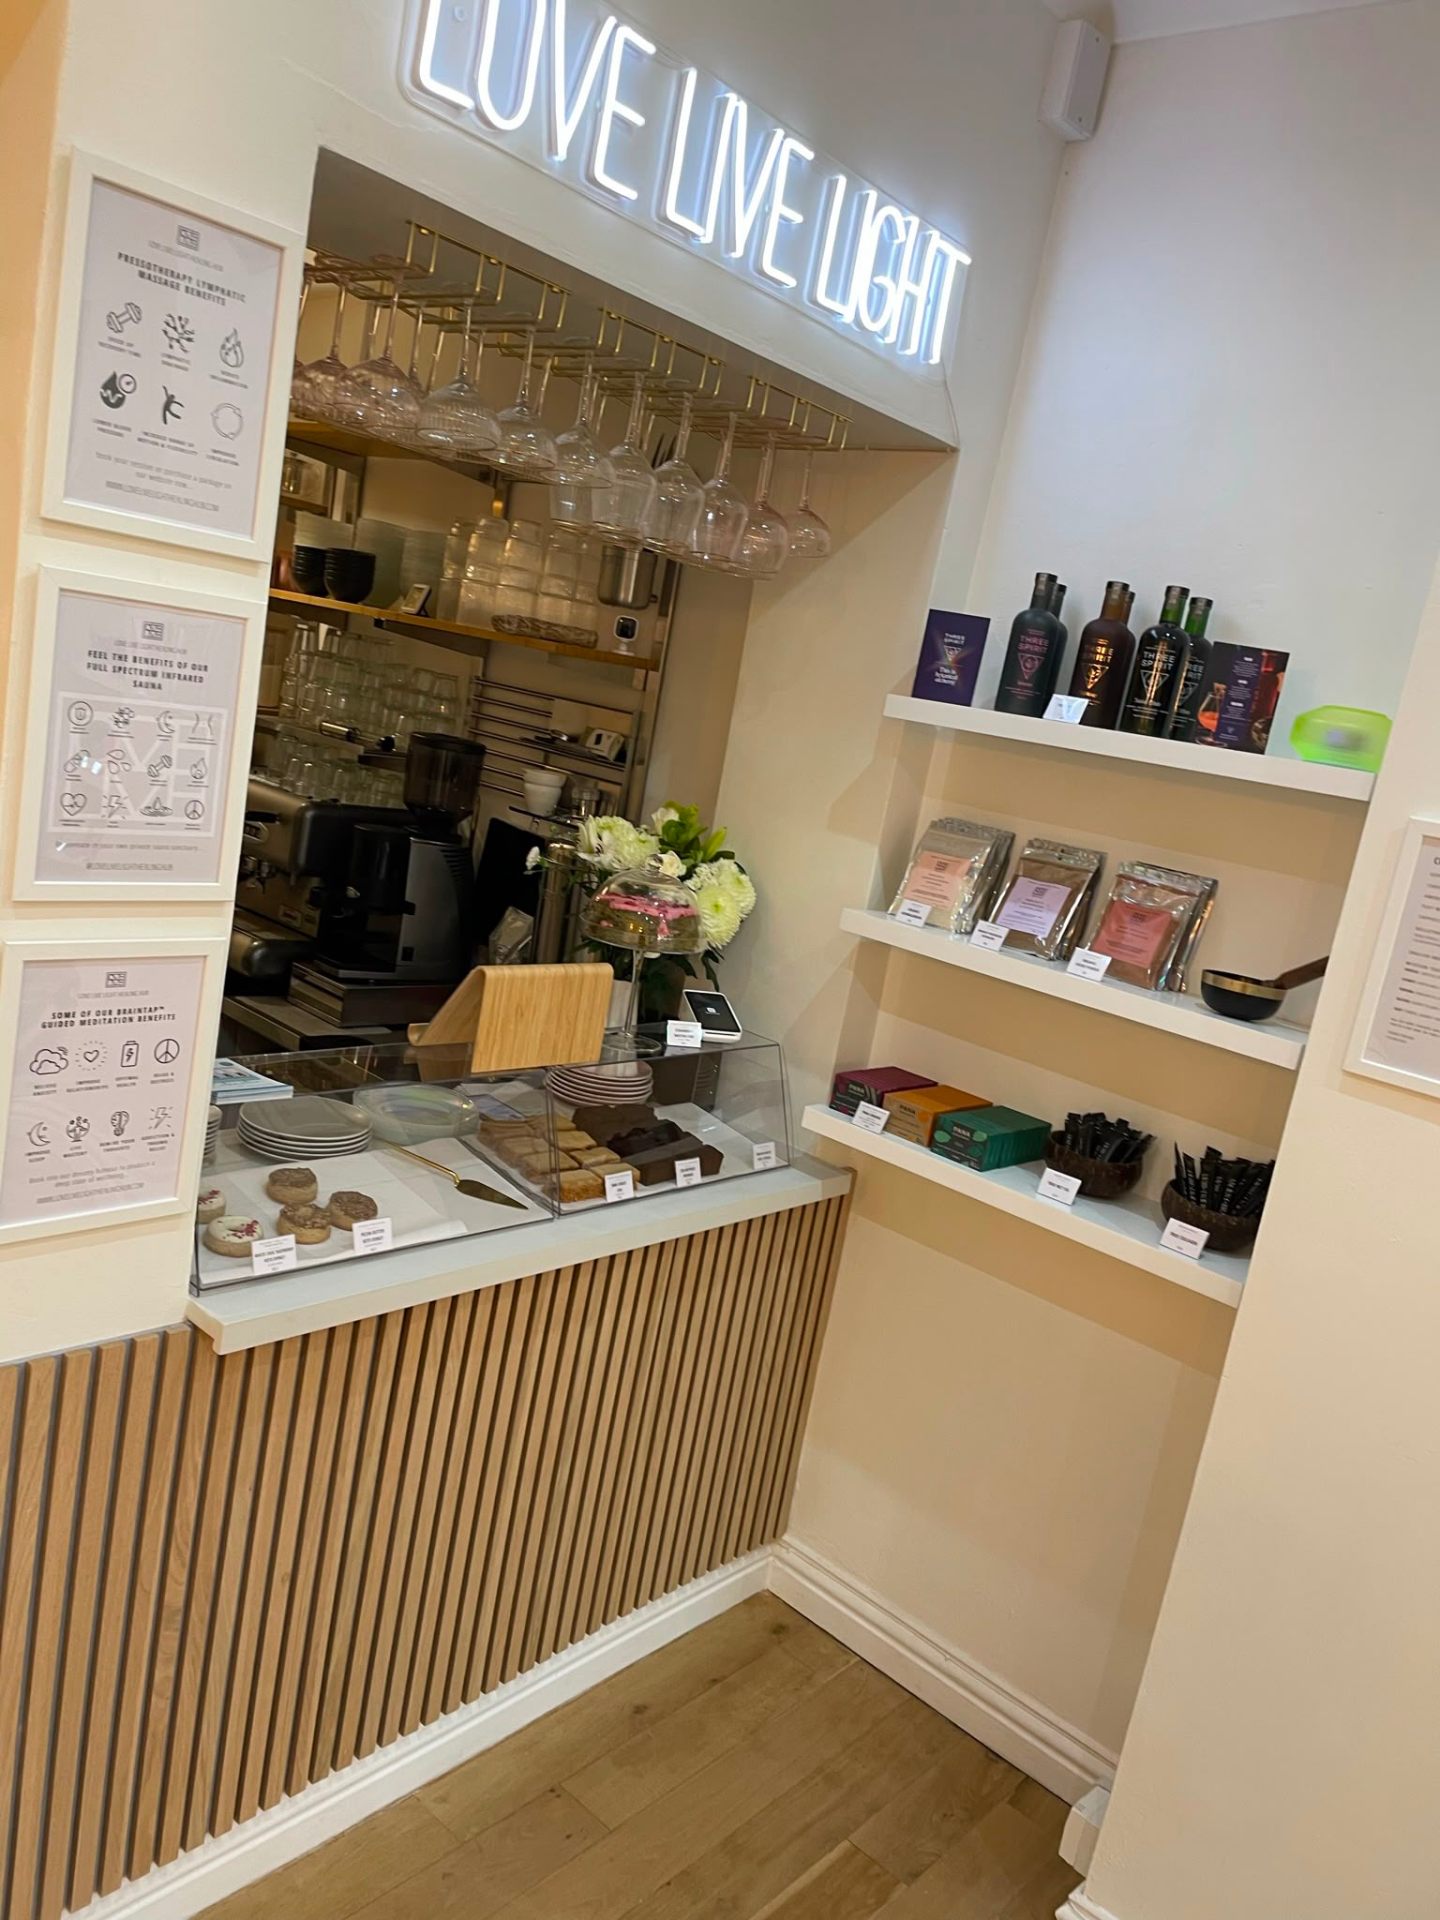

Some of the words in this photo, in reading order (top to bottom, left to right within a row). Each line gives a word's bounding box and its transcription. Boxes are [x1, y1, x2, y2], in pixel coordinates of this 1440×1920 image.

[418, 0, 657, 200] LOVE
[666, 67, 815, 289] LIVE
[816, 174, 973, 365] LIGHT
[117, 251, 193, 283] PRESSOTHERAPY
[196, 279, 246, 304] LYMPHATIC
[138, 269, 181, 292] MASSAGE
[184, 285, 226, 306] BENEFITS
[87, 649, 108, 660] FEEL
[111, 653, 128, 663] THE
[132, 655, 173, 668] BENEFITS
[176, 661, 188, 670] OF
[191, 663, 209, 672] OUR
[86, 662, 108, 672] FULL
[111, 665, 159, 678] SPECTRUM
[161, 671, 205, 684] INFRARED
[132, 680, 162, 690] SAUNA
[41, 1020, 76, 1029] GUIDED
[79, 1016, 134, 1027] MEDITATION
[137, 1013, 177, 1023] BENEFITS
[51, 1010, 77, 1020] SOME
[80, 1009, 92, 1018] OF
[95, 1008, 113, 1017] OUR
